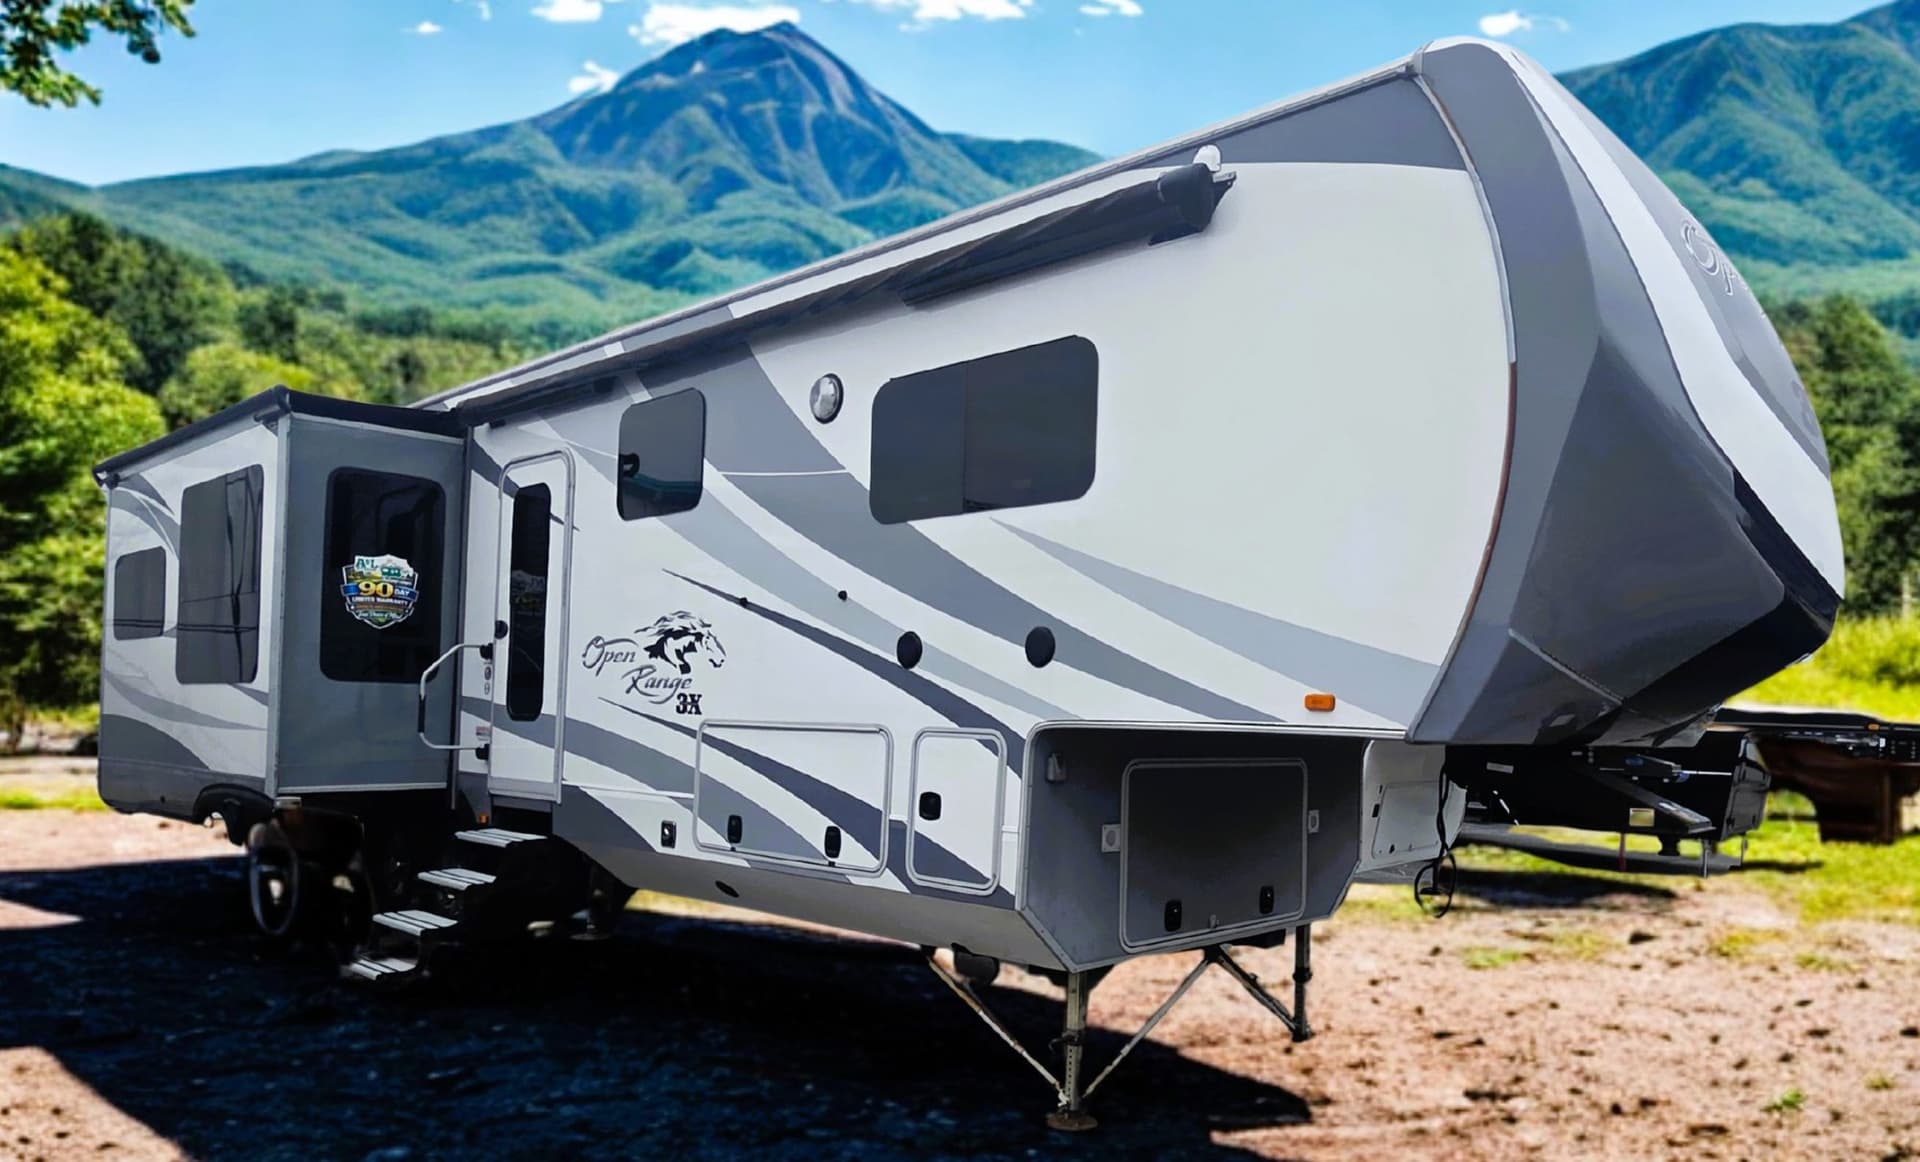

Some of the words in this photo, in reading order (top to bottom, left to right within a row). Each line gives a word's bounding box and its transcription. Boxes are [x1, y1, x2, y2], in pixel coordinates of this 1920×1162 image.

[358, 581, 393, 597] 90
[394, 588, 410, 597] DAY
[582, 635, 639, 677] Open
[621, 664, 693, 705] Range
[676, 692, 703, 716] 3X
